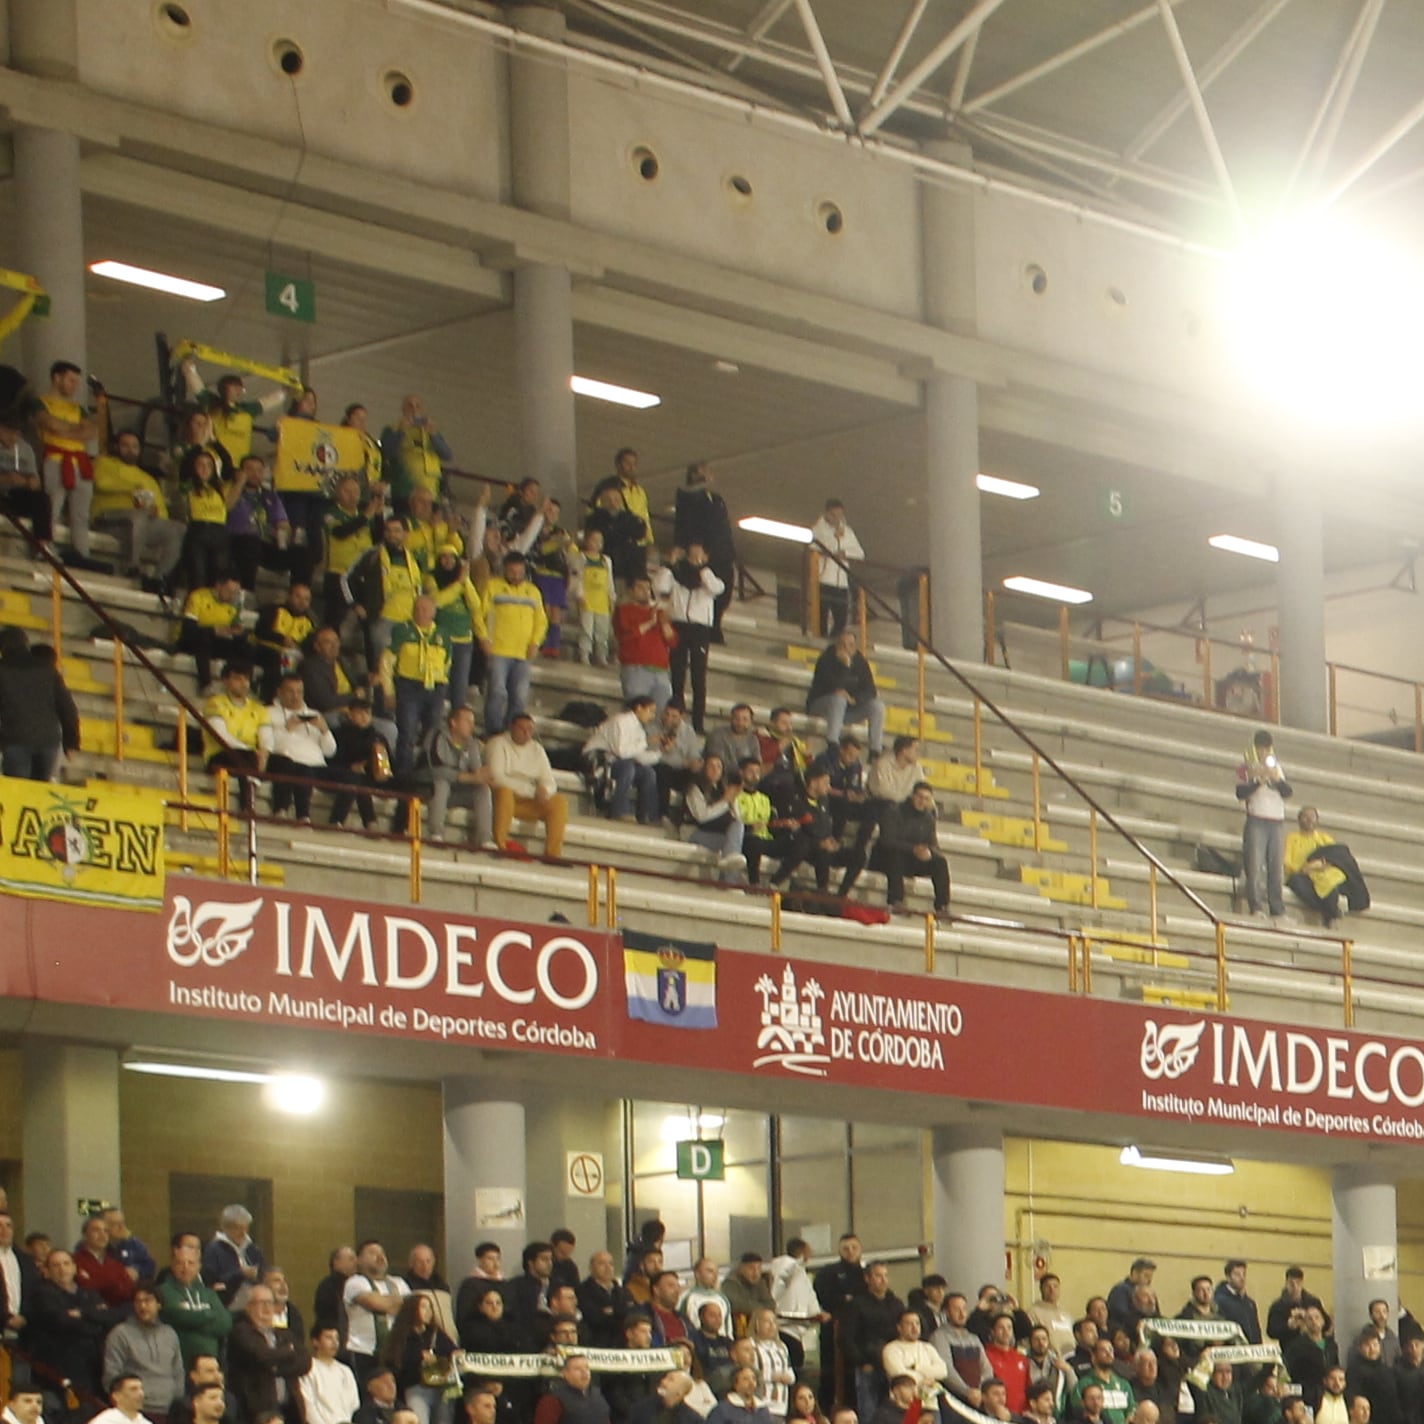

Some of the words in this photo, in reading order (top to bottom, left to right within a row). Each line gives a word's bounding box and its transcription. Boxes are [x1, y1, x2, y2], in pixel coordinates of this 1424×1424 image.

[278, 283, 299, 313] 4
[1108, 492, 1124, 516] 5
[0, 797, 159, 876] AÉN
[274, 900, 599, 1011] IMDECO
[169, 980, 263, 1014] Instituto
[268, 991, 375, 1027] Municipal
[380, 1004, 407, 1030] de
[412, 1011, 508, 1041] Deportes
[512, 1018, 597, 1050] Córdoba
[830, 989, 963, 1037] AYUNTAMIENTO
[830, 1026, 855, 1060] DE
[857, 1027, 945, 1071] CÓRDOBA
[1142, 1089, 1204, 1116] Instituto
[1207, 1096, 1280, 1126] Municipal
[1282, 1106, 1302, 1127] de
[1305, 1107, 1370, 1134] Deportes
[690, 1148, 711, 1176] D
